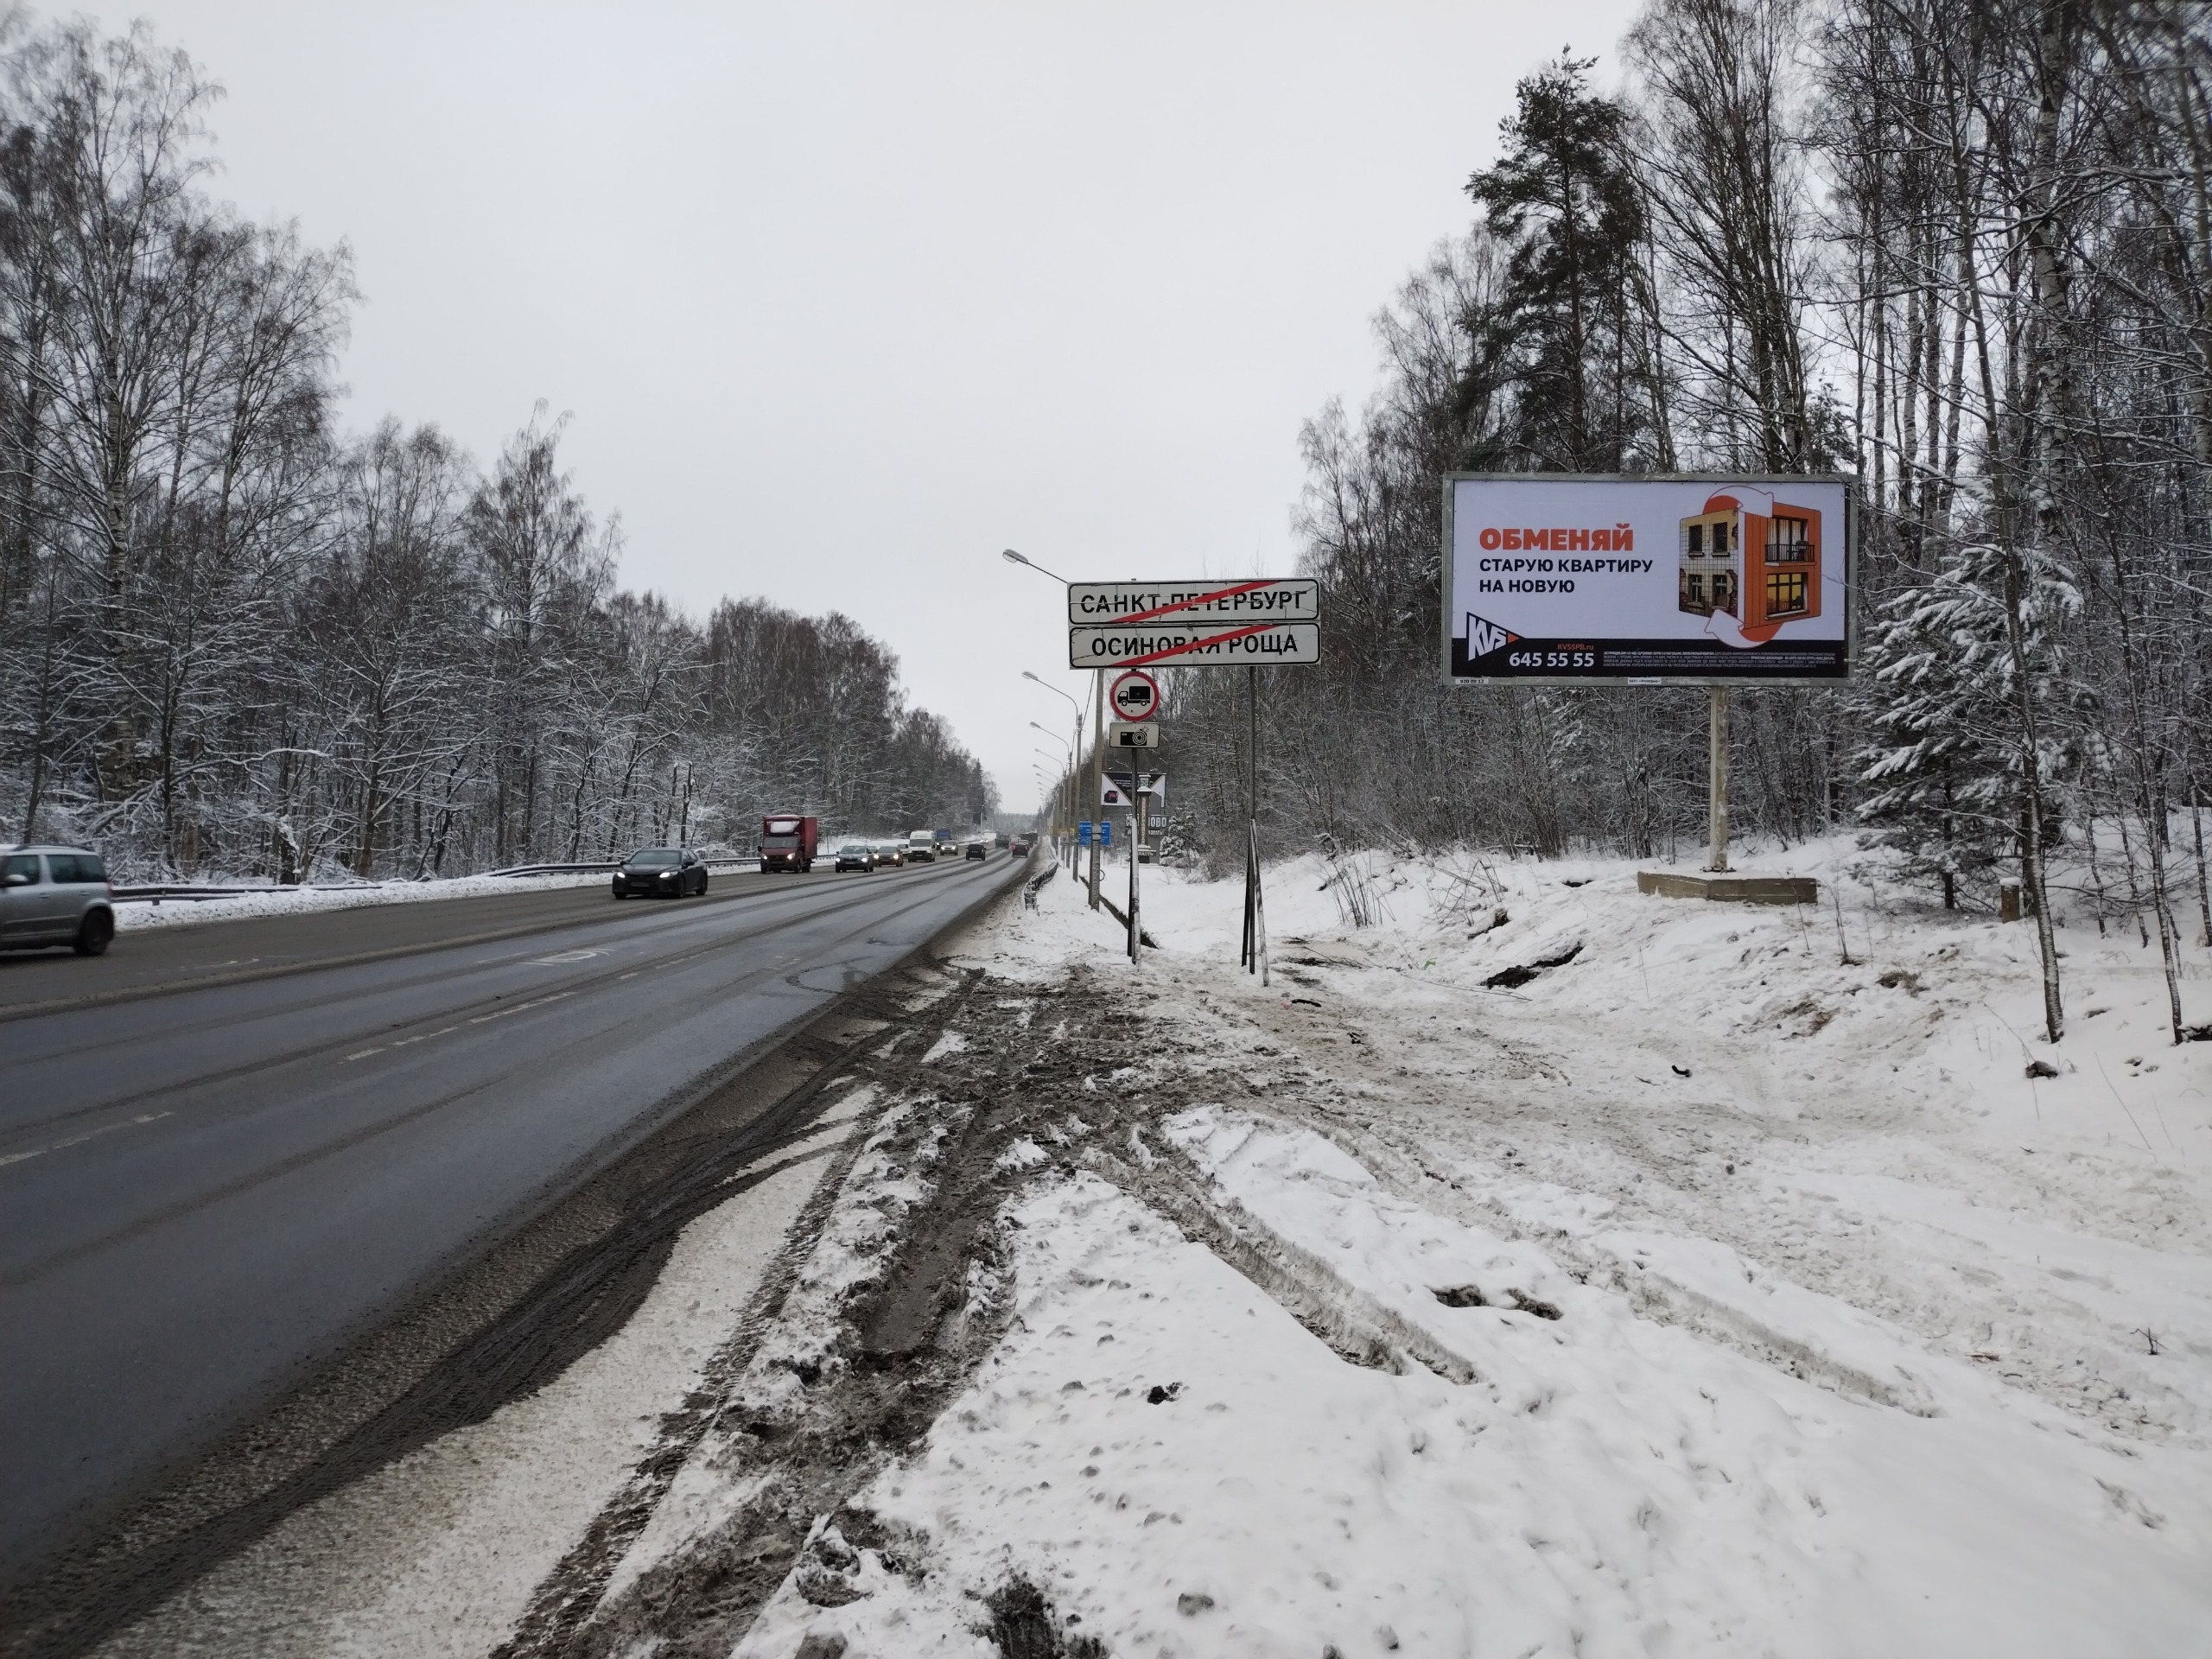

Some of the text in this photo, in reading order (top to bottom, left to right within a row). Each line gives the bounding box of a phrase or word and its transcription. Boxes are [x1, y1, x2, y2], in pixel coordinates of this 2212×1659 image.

[1479, 523, 1633, 551] ОБМЕНЯЙ
[1479, 558, 1653, 573] СТАРУЮ КВАРТИРУ
[1479, 579, 1575, 593] НА НОВУЮ
[1080, 590, 1307, 613] САНКТ-ПЕТЕРБУРГ
[1091, 633, 1299, 657] ОСИНОВАЯ РОЩА
[1468, 613, 1507, 662] KVS
[1509, 652, 1542, 667] 645
[1547, 652, 1568, 667] 55
[1573, 652, 1595, 667] 55
